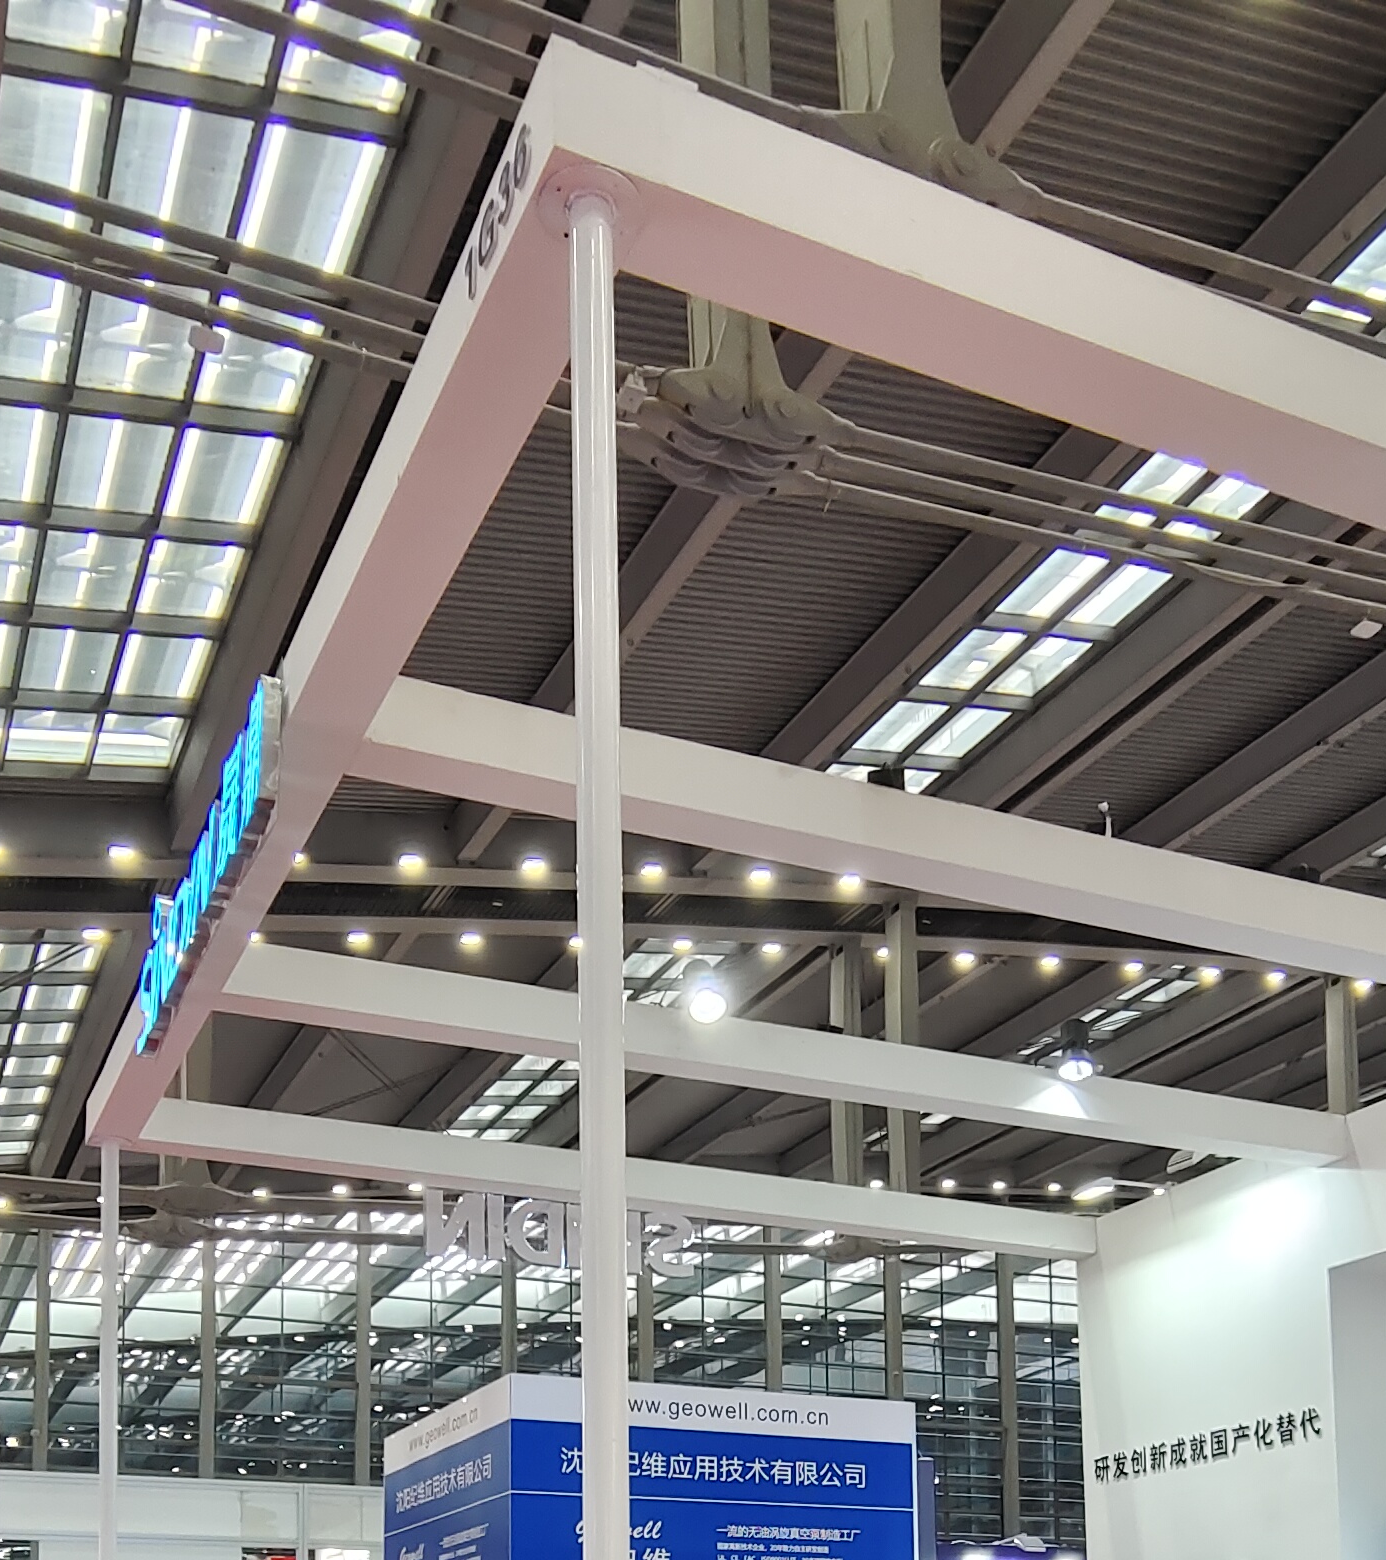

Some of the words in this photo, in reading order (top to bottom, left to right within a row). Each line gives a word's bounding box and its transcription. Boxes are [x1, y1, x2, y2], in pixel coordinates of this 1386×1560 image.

[465, 123, 532, 301] 1G36
[628, 1397, 829, 1426] ww.geowell.com.cn
[1094, 1408, 1322, 1484] 研发创新成就国产化替代
